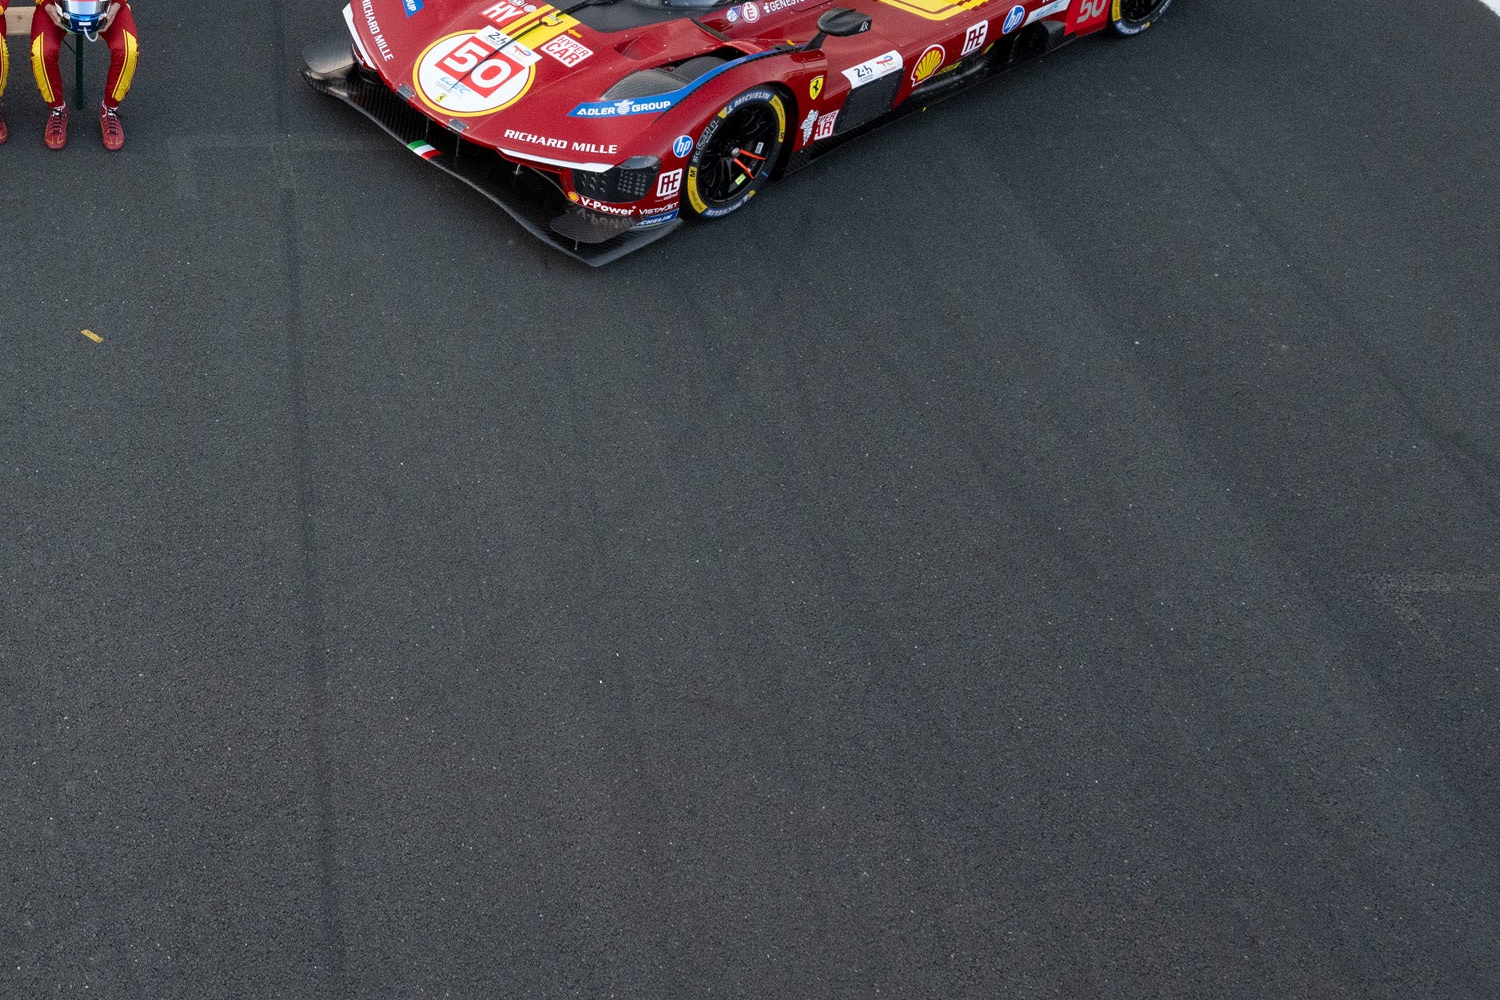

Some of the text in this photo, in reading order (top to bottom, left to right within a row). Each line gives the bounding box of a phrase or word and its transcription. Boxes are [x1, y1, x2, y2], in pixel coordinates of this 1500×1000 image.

[481, 1, 524, 23] HY
[1004, 8, 1024, 32] hp
[374, 31, 394, 62] MILLE
[545, 42, 580, 65] CAR
[556, 36, 589, 58] HYPER
[443, 41, 512, 88] 50
[577, 100, 671, 116] ADLER GROUP
[734, 91, 771, 107] MICHELIN
[504, 129, 618, 154] RICHARD MILLE
[675, 137, 692, 157] hp
[581, 196, 635, 216] V-Power
[639, 202, 679, 215] VISTAJET
